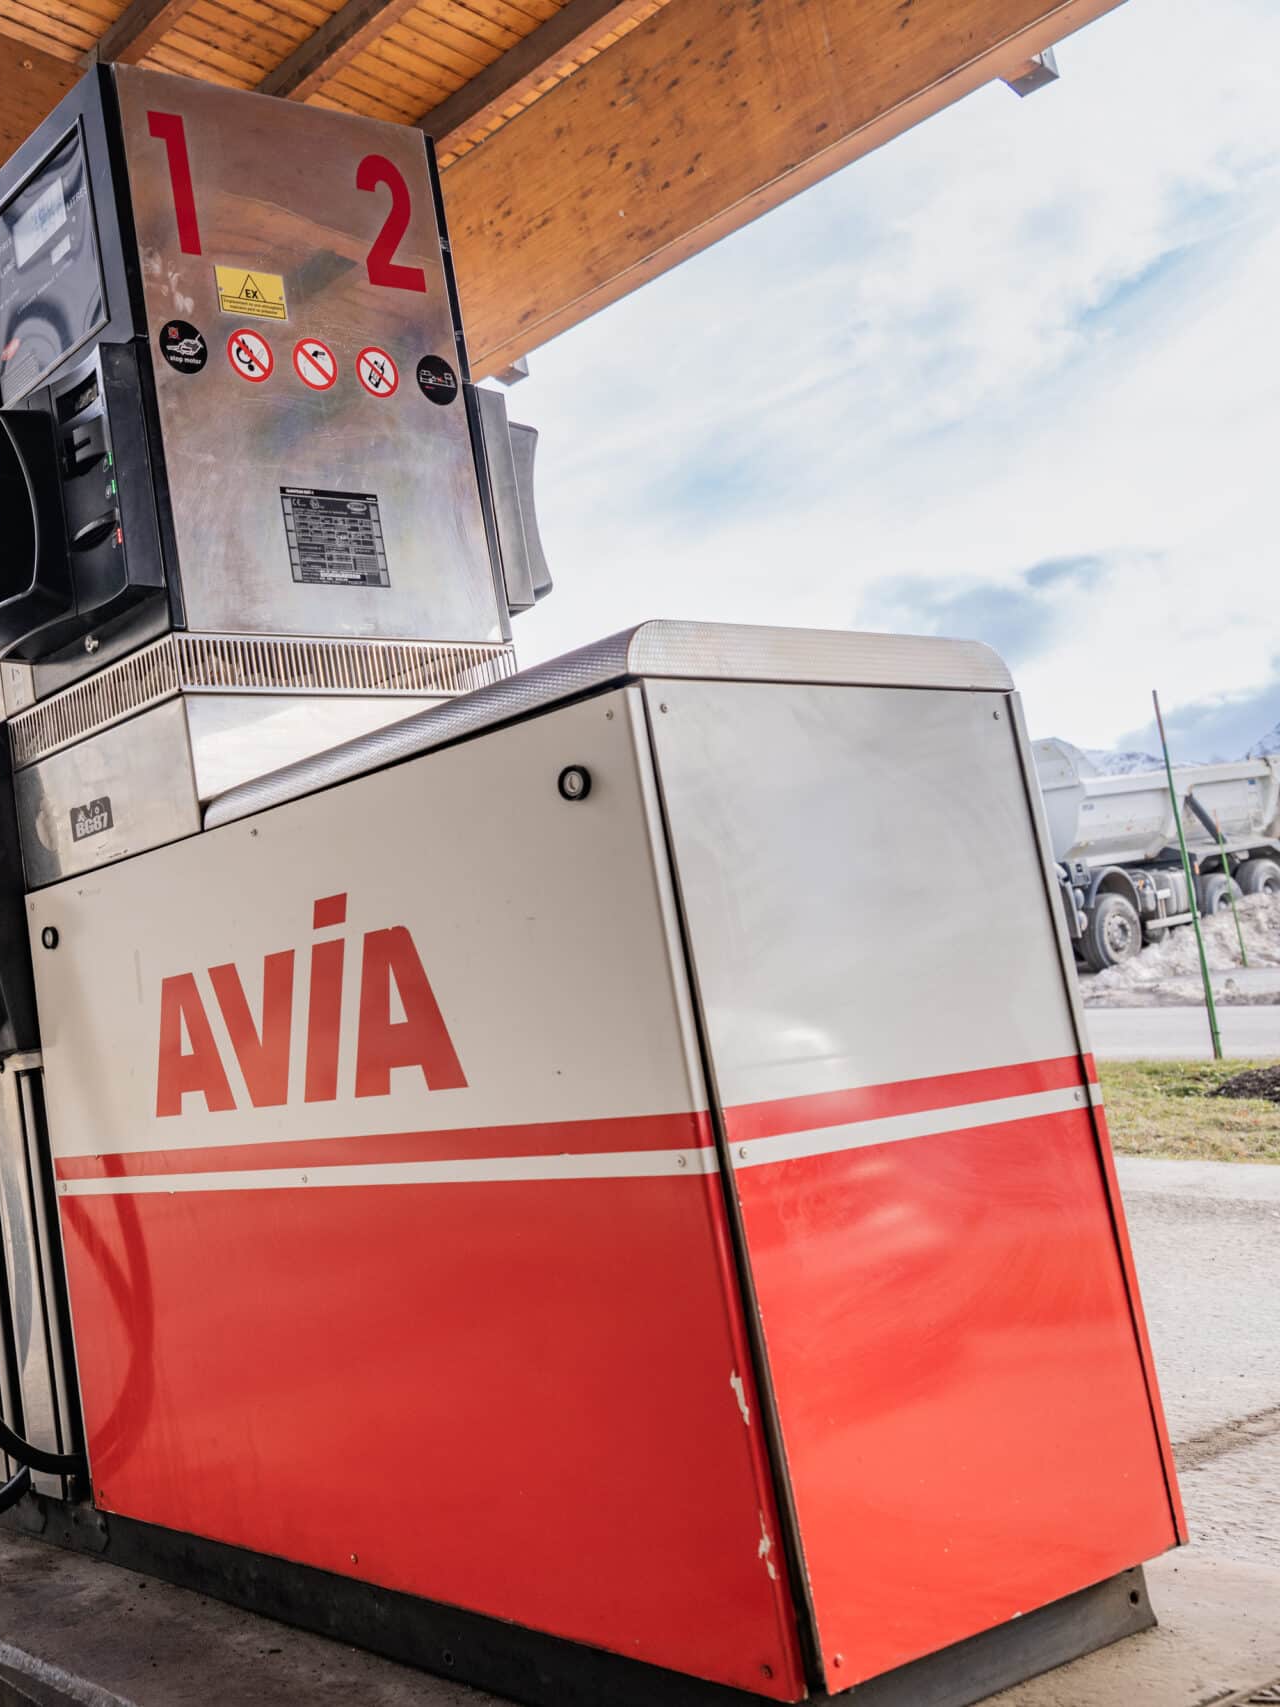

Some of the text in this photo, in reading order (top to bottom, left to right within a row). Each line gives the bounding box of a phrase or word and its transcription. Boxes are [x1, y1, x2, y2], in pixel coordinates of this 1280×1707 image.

[147, 111, 202, 256] 1
[356, 154, 427, 293] 2
[245, 288, 258, 299] EX
